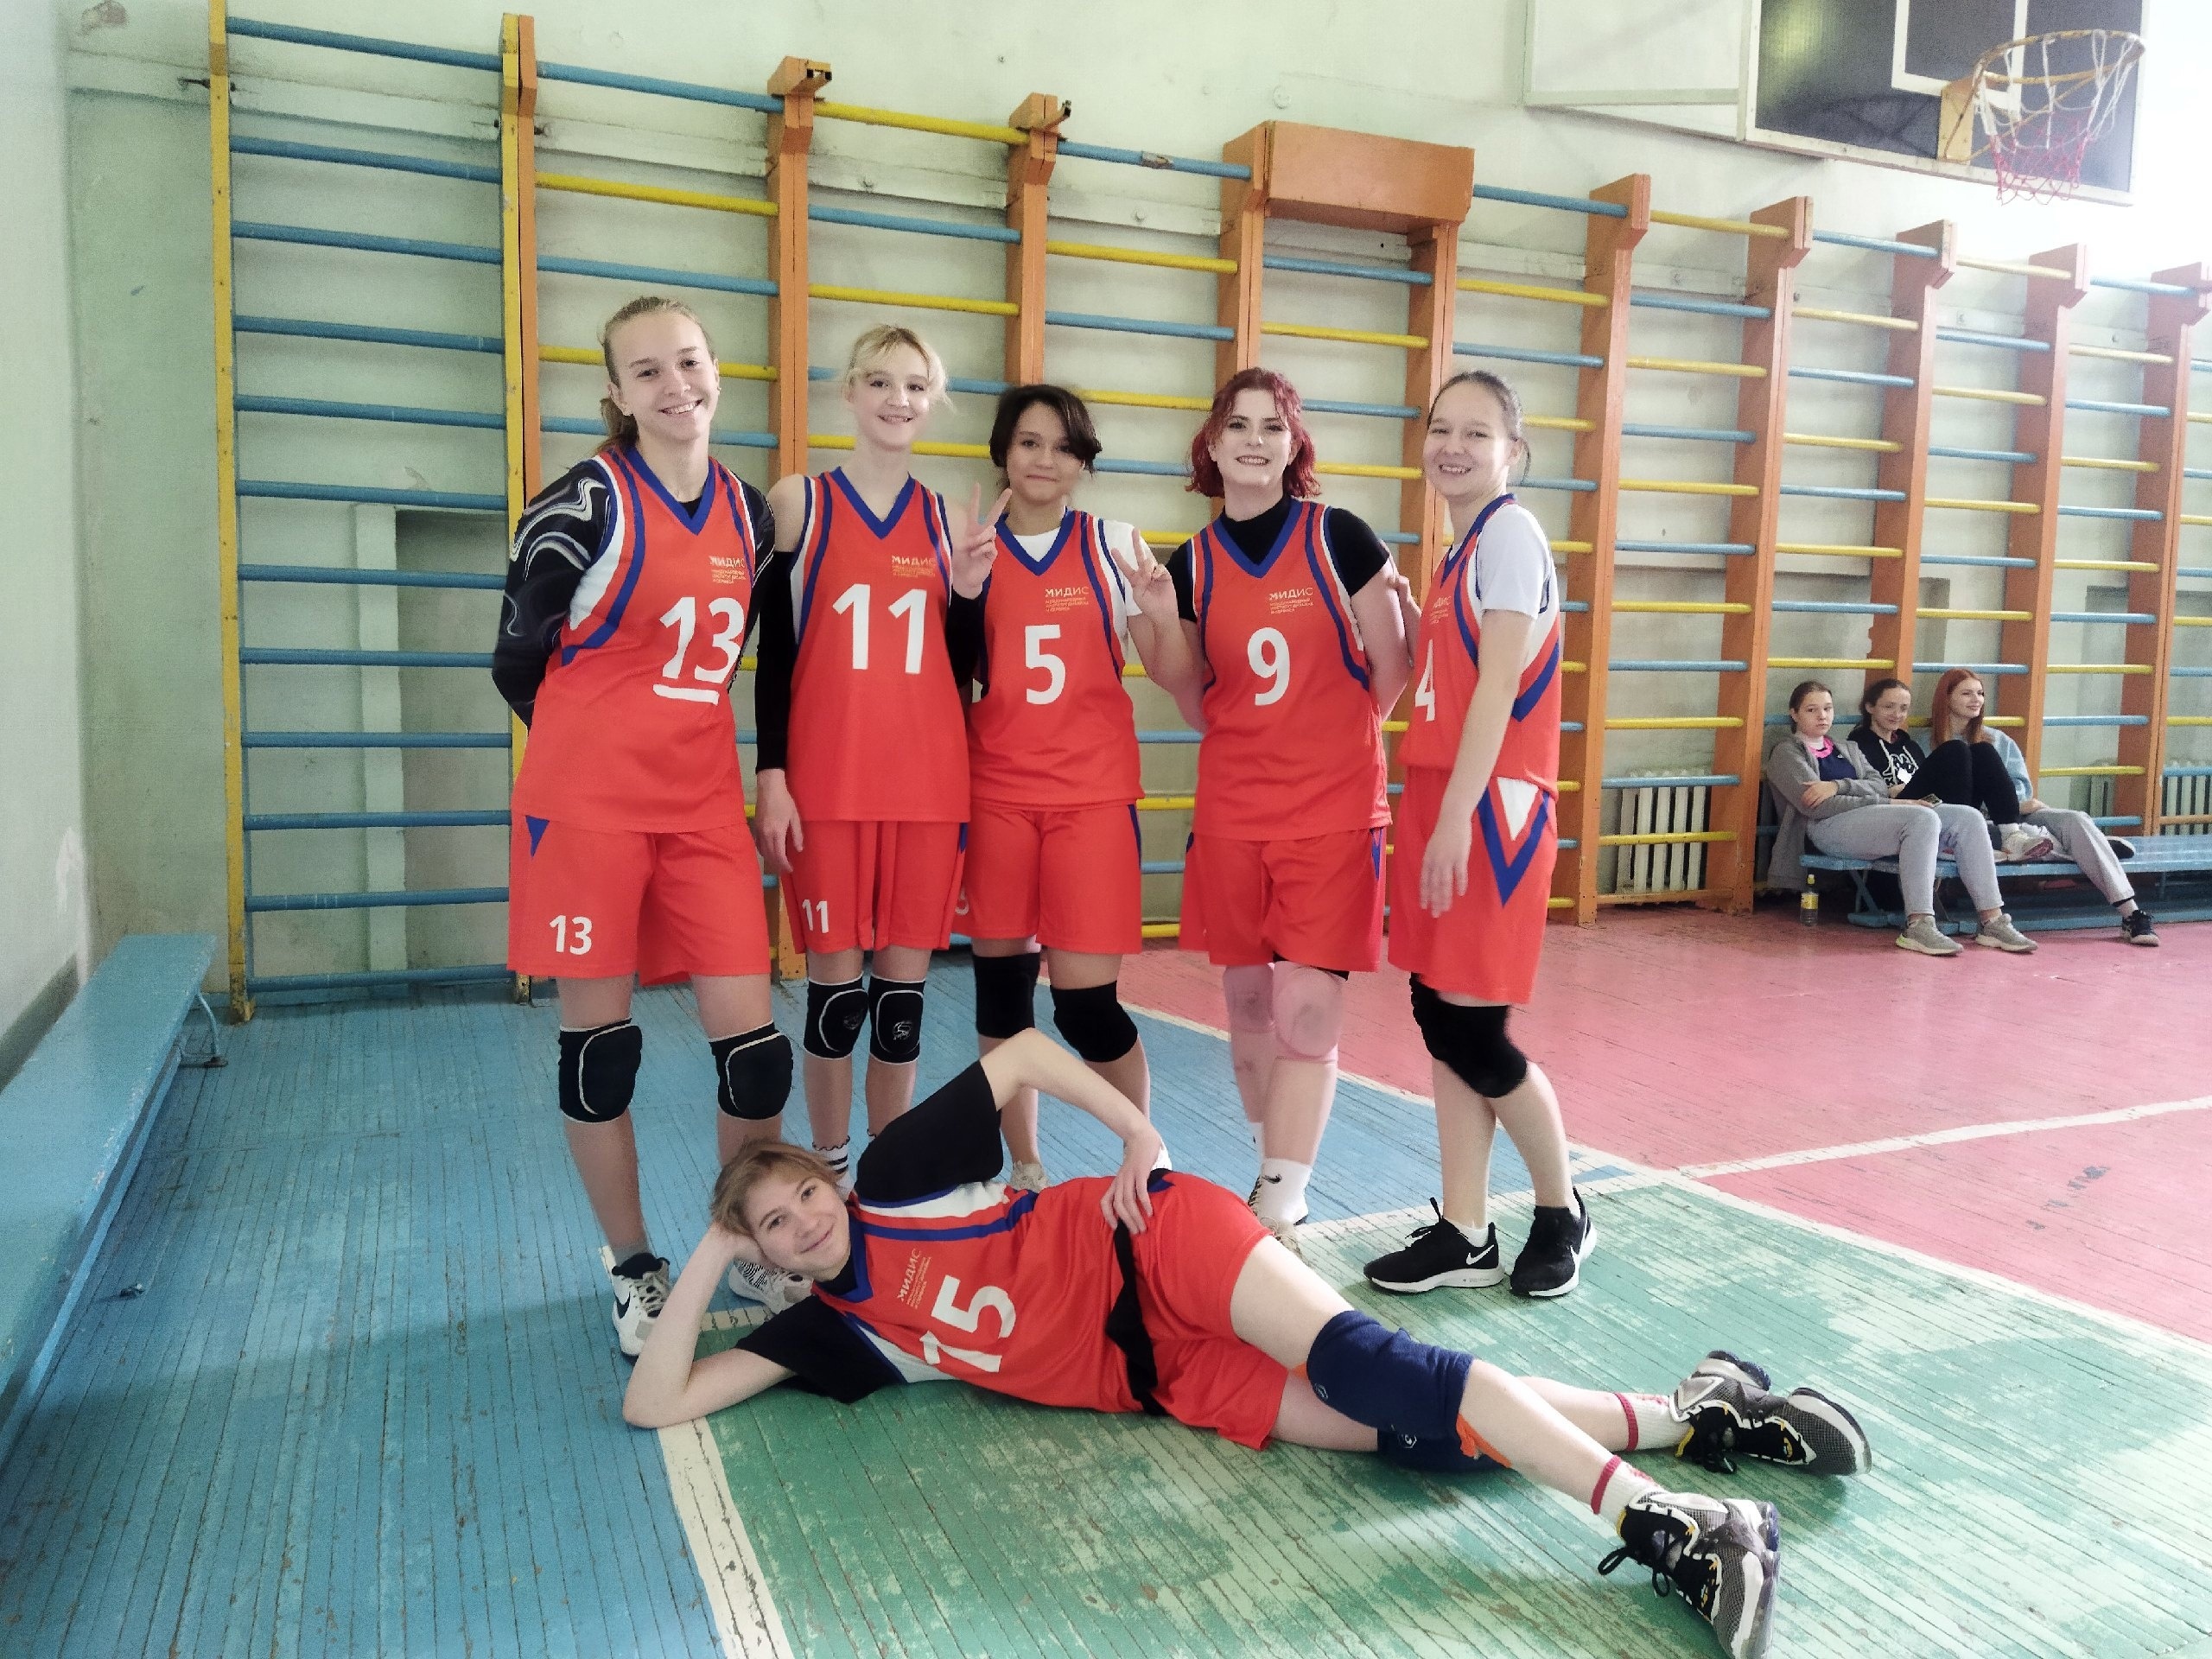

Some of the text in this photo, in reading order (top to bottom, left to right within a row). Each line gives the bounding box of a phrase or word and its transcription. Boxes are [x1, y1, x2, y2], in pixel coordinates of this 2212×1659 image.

[832, 583, 927, 674] 11
[1045, 586, 1089, 597] МИДИС
[1268, 587, 1313, 601] МИДИС
[659, 596, 745, 683] 13
[1024, 624, 1066, 705] 5
[1247, 626, 1291, 706] 9
[1414, 639, 1436, 722] 4
[549, 915, 593, 956] 13
[802, 899, 830, 934] 11
[919, 1274, 1016, 1373] 15
